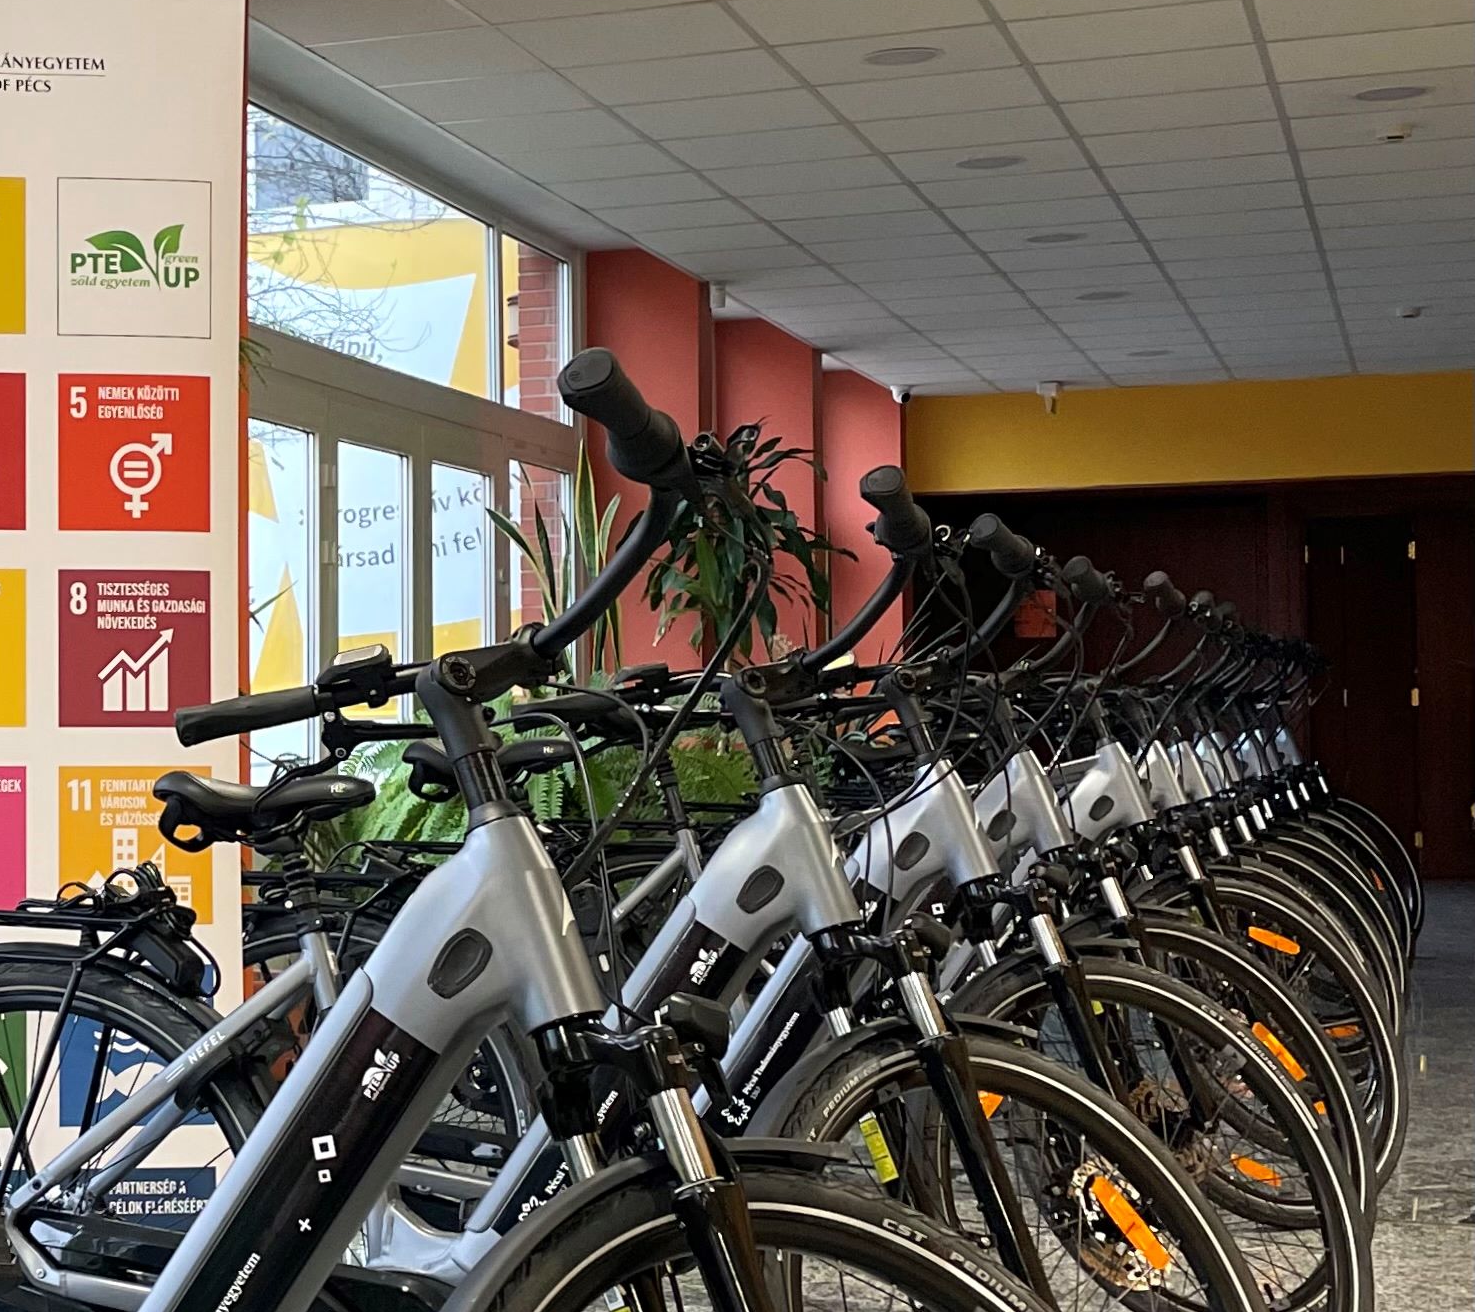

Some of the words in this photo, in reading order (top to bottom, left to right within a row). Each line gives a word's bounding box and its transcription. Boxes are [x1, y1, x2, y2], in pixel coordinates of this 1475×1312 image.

[15, 77, 52, 93] PÉCS
[70, 253, 118, 274] PTE
[164, 255, 198, 265] green
[100, 277, 151, 289] egyetem
[164, 266, 200, 288] UP
[98, 386, 134, 400] NEMEK
[137, 385, 180, 401] KÖZÖTTI
[69, 386, 88, 419] 5
[98, 403, 164, 420] EGYENLŐSÉG
[97, 580, 170, 596] TISZTESSÉGES
[69, 581, 87, 615] 8
[97, 599, 135, 613] MUNKA
[137, 597, 150, 613] ÉS
[151, 597, 206, 614] GAZDASÁGI
[97, 614, 157, 630] NÖVEKEDÉS
[100, 778, 155, 793] FENNTART
[66, 778, 91, 811] 11
[100, 794, 147, 810] VÁROSOK
[100, 810, 113, 826] ÉS
[115, 810, 160, 826] KÖZÖSSÉ
[187, 1031, 226, 1064] NEFEL
[178, 1180, 187, 1194] A
[109, 1198, 144, 1215] CÉLOK
[881, 1218, 928, 1243] CST
[949, 1251, 1028, 1312] PEDIUM
